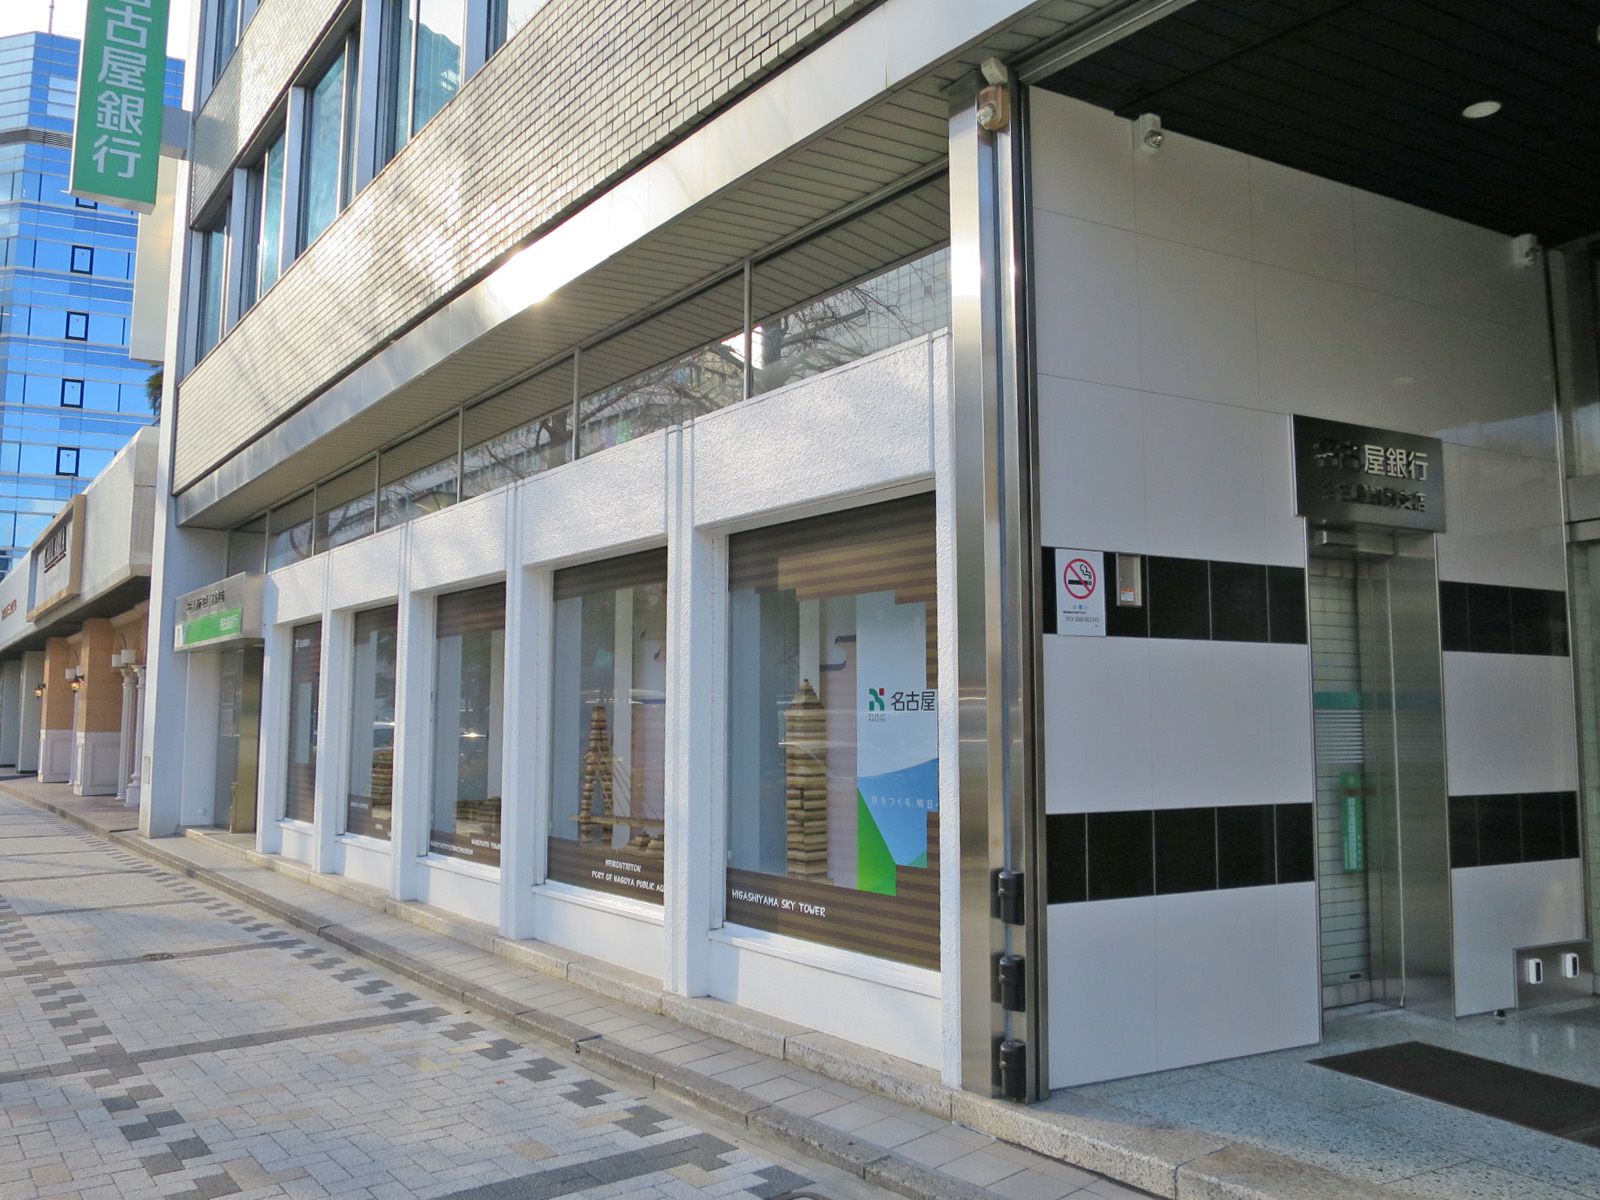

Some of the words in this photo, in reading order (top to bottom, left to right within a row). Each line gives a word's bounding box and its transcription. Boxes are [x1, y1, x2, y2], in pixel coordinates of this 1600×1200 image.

[92, 0, 152, 178] 古屋銀行
[891, 691, 936, 712] 名古屋
[591, 870, 605, 880] PORT
[605, 873, 613, 881] OF
[613, 875, 635, 887] NAGOYA
[636, 880, 655, 890] PUBLIC
[731, 888, 779, 908] HIGASHIYAMA
[781, 899, 795, 911] SKY
[799, 902, 826, 918] TOWER
